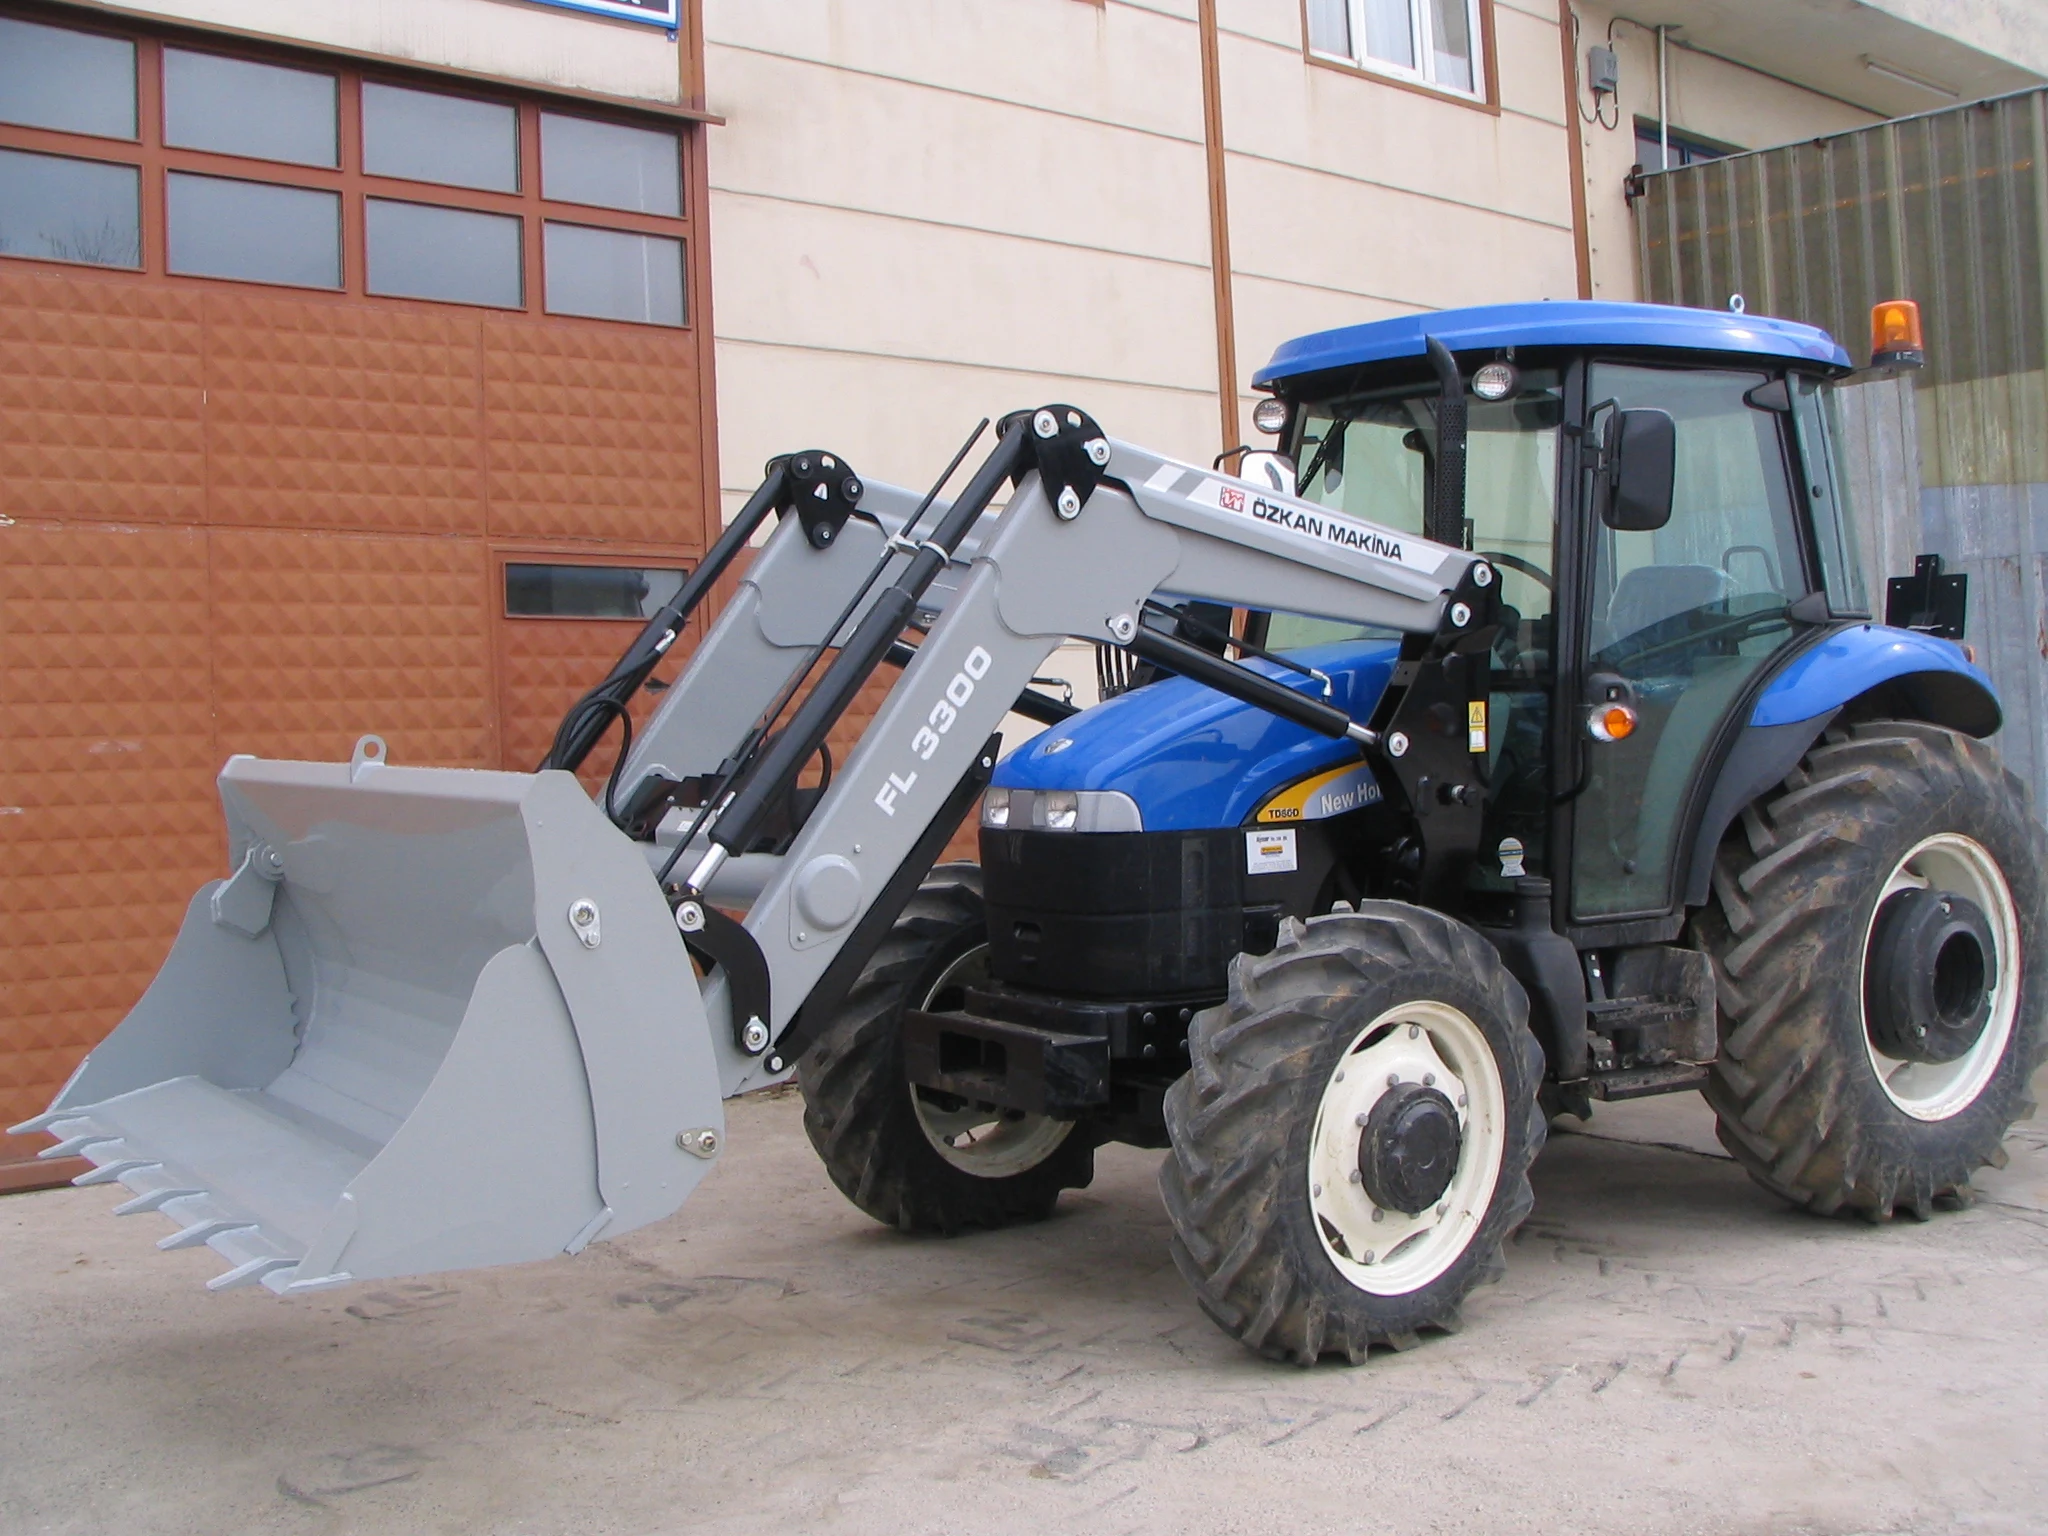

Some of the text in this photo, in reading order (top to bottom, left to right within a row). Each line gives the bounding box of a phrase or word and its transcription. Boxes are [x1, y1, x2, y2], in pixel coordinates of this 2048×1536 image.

[1252, 497, 1402, 561] ÖZKAN MAKİNA
[874, 645, 993, 817] FL 3300
[1321, 792, 1354, 815] New
